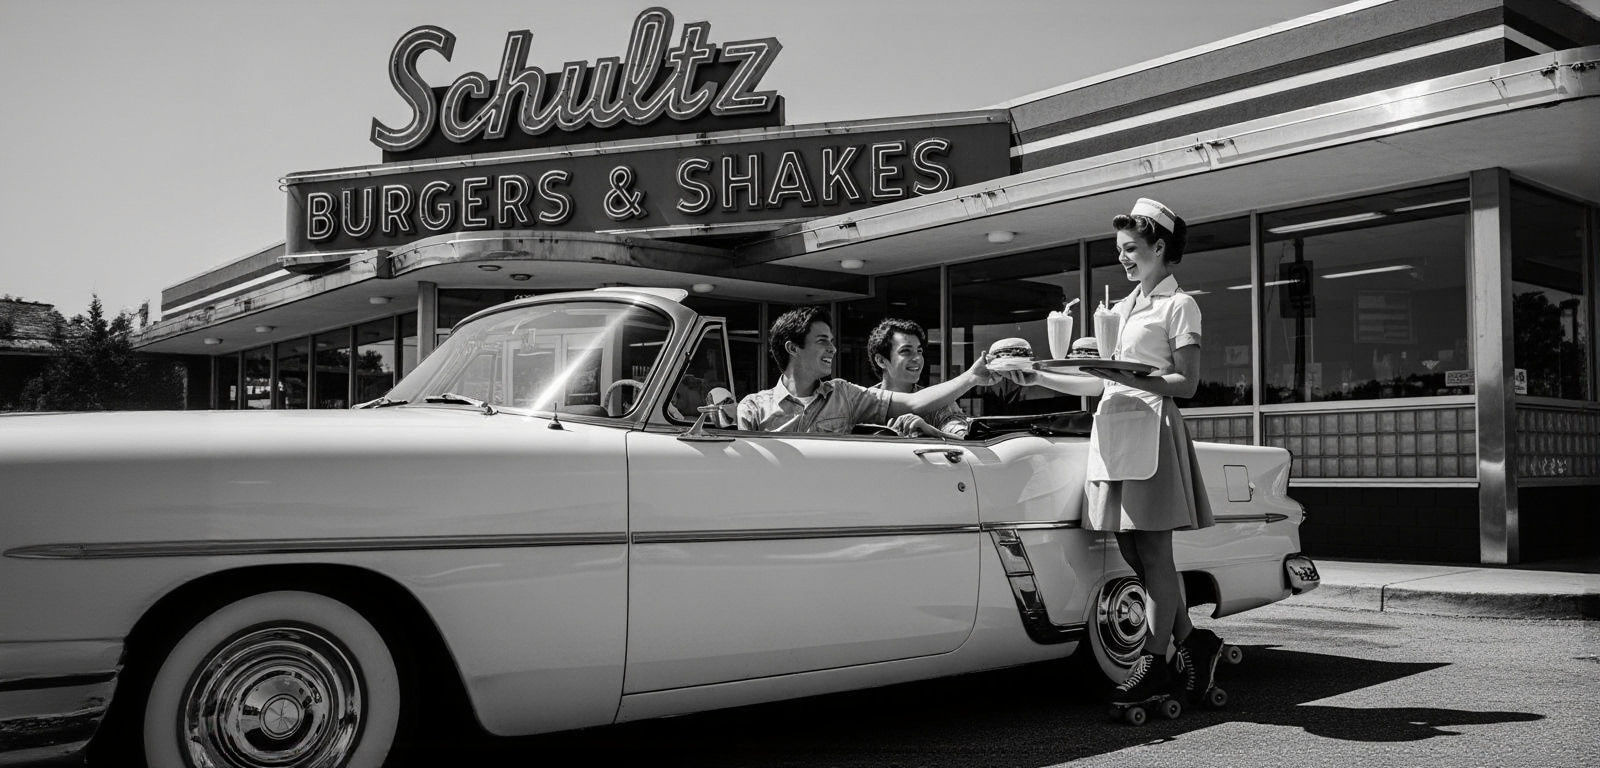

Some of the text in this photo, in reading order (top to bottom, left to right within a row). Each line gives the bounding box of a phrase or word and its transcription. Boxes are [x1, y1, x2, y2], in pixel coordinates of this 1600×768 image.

[371, 6, 783, 153] Schultz
[306, 138, 955, 242] BURGERS & SHAKES
